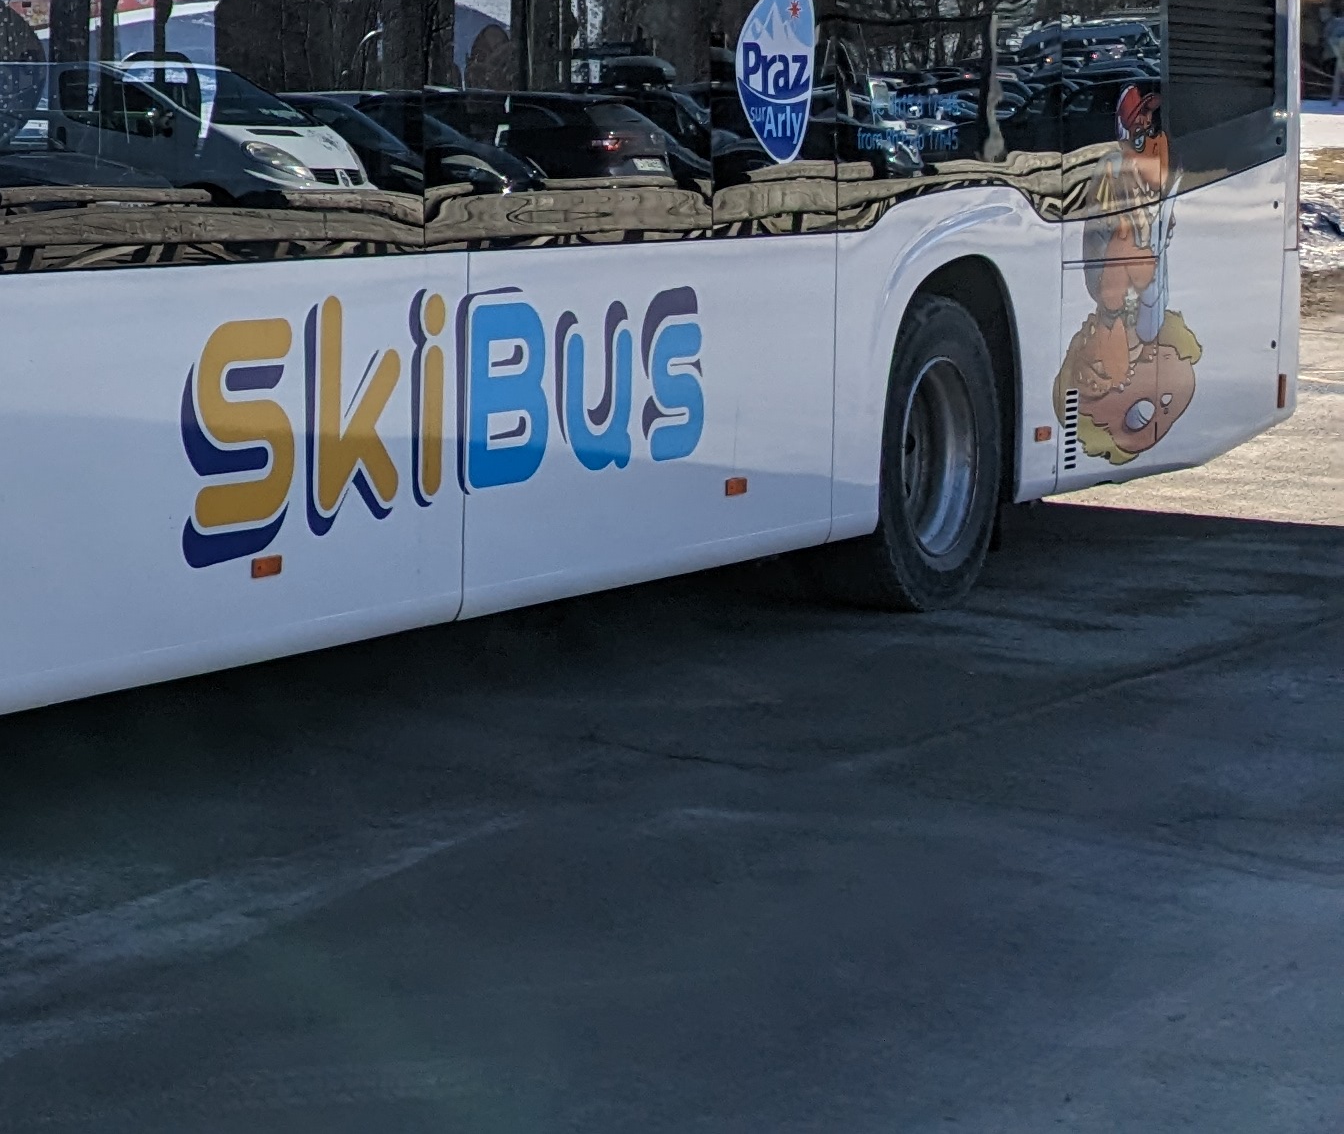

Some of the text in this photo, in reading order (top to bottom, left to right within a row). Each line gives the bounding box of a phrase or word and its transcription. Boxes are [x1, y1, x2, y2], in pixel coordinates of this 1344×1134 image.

[743, 42, 808, 96] Praz
[750, 105, 803, 145] sur Arly
